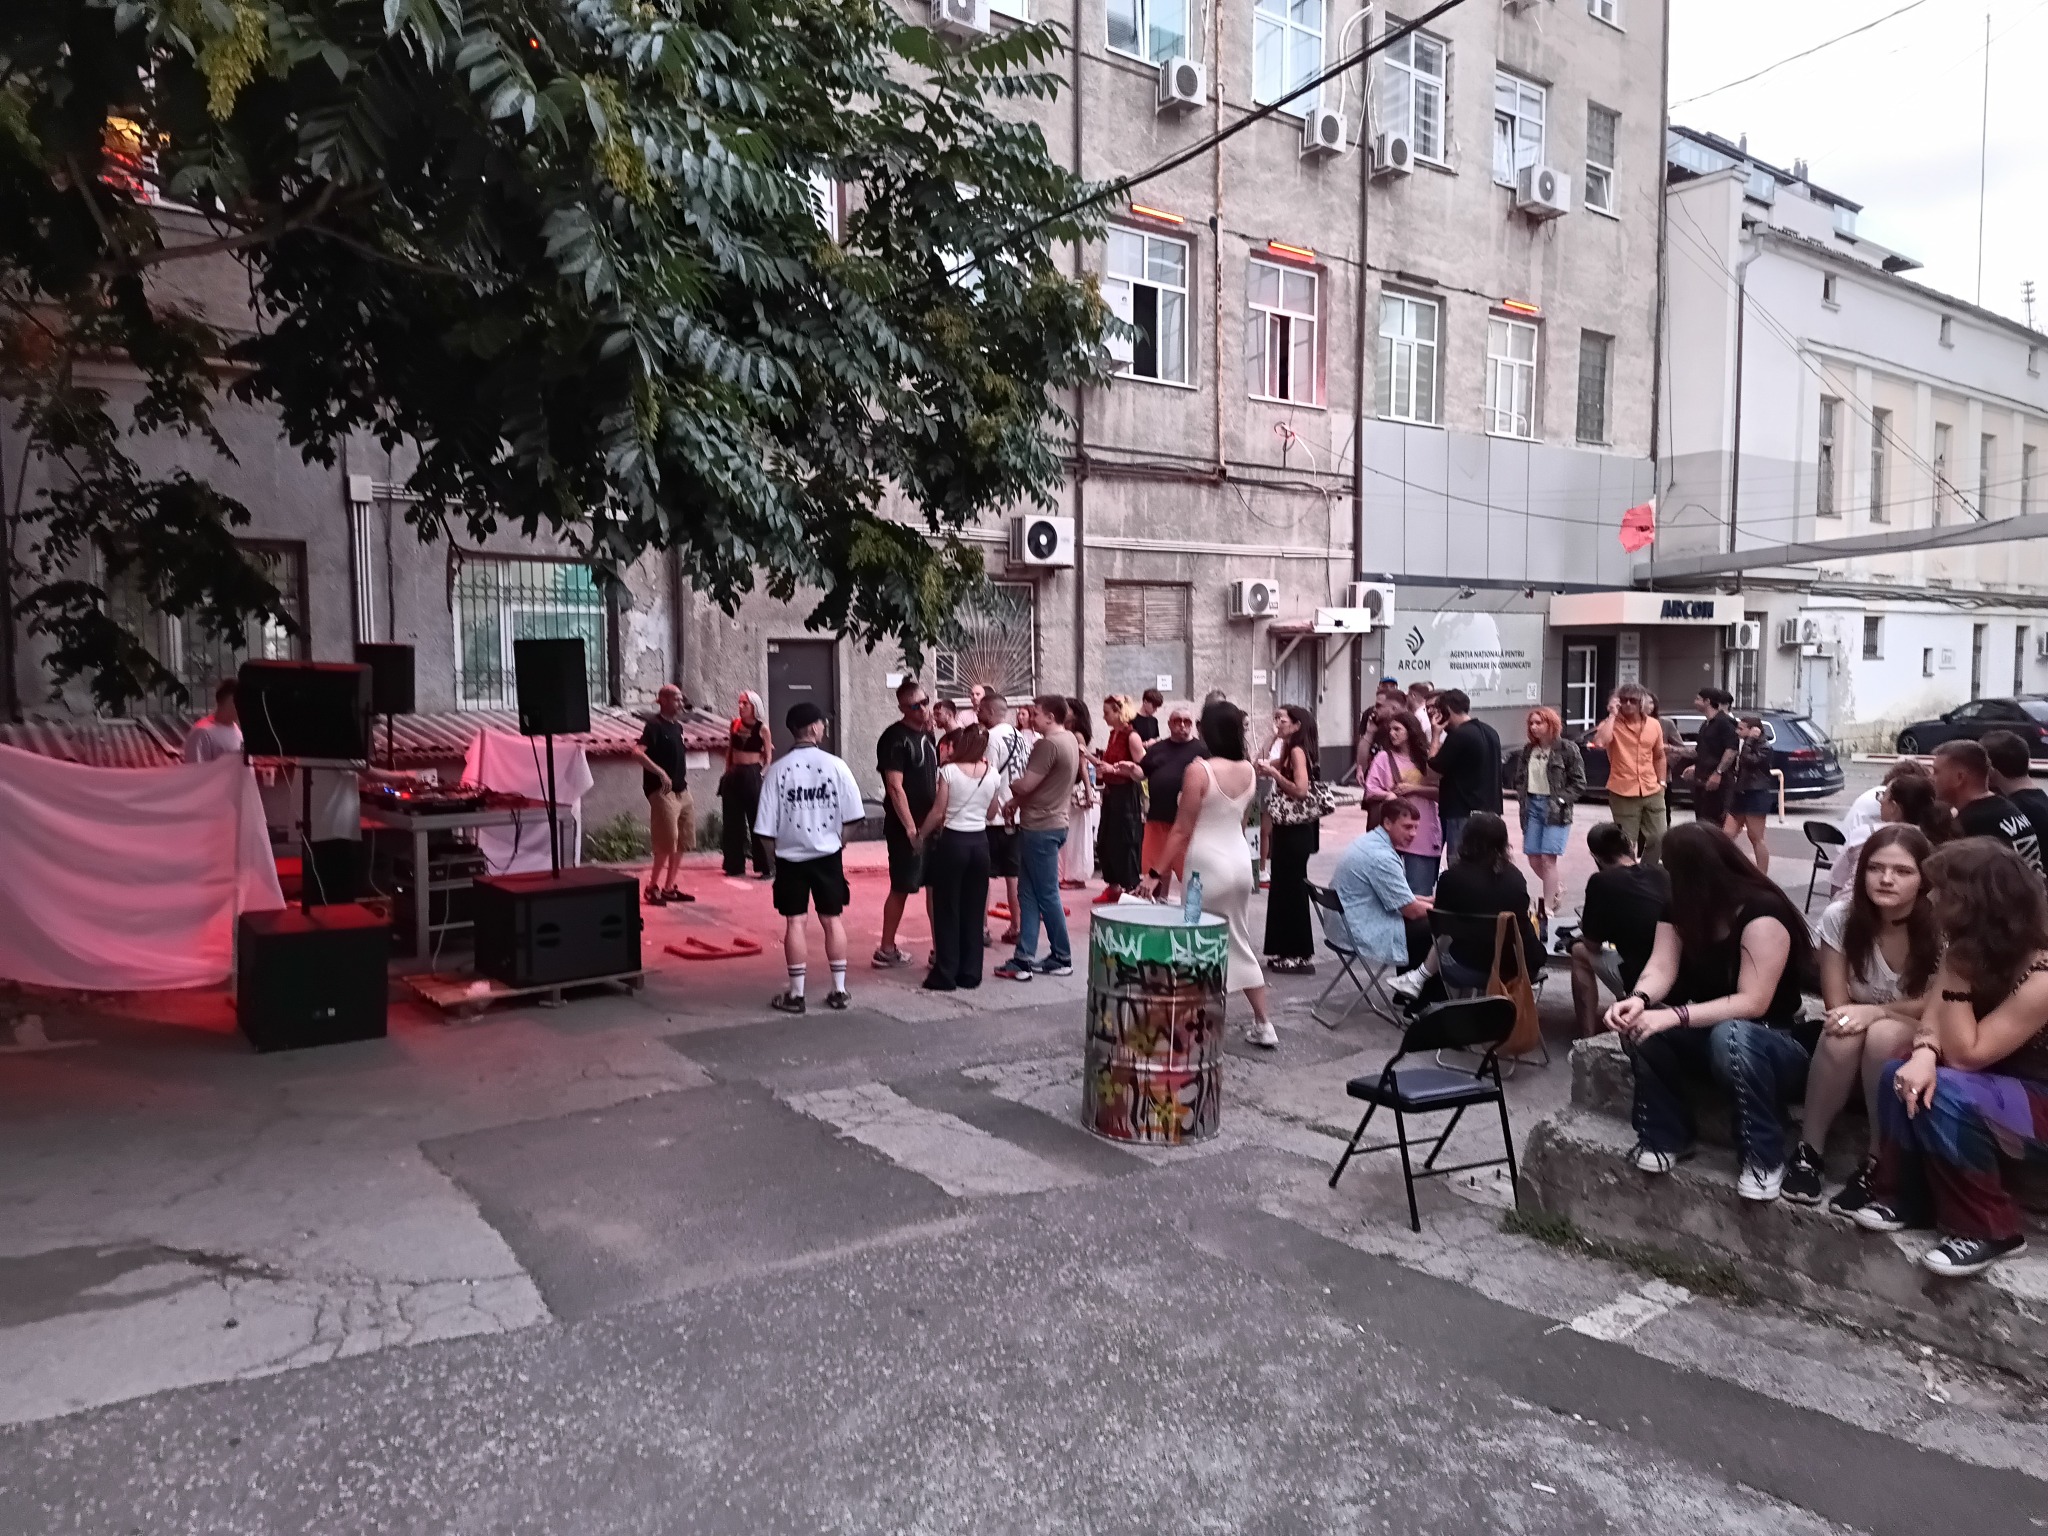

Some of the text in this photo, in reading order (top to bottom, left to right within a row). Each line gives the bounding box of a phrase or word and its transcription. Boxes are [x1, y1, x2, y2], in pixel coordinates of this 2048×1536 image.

[1505, 650, 1525, 658] PENTRU
[1398, 660, 1431, 671] ARCOM
[1450, 662, 1490, 670] REGLEMENTARE
